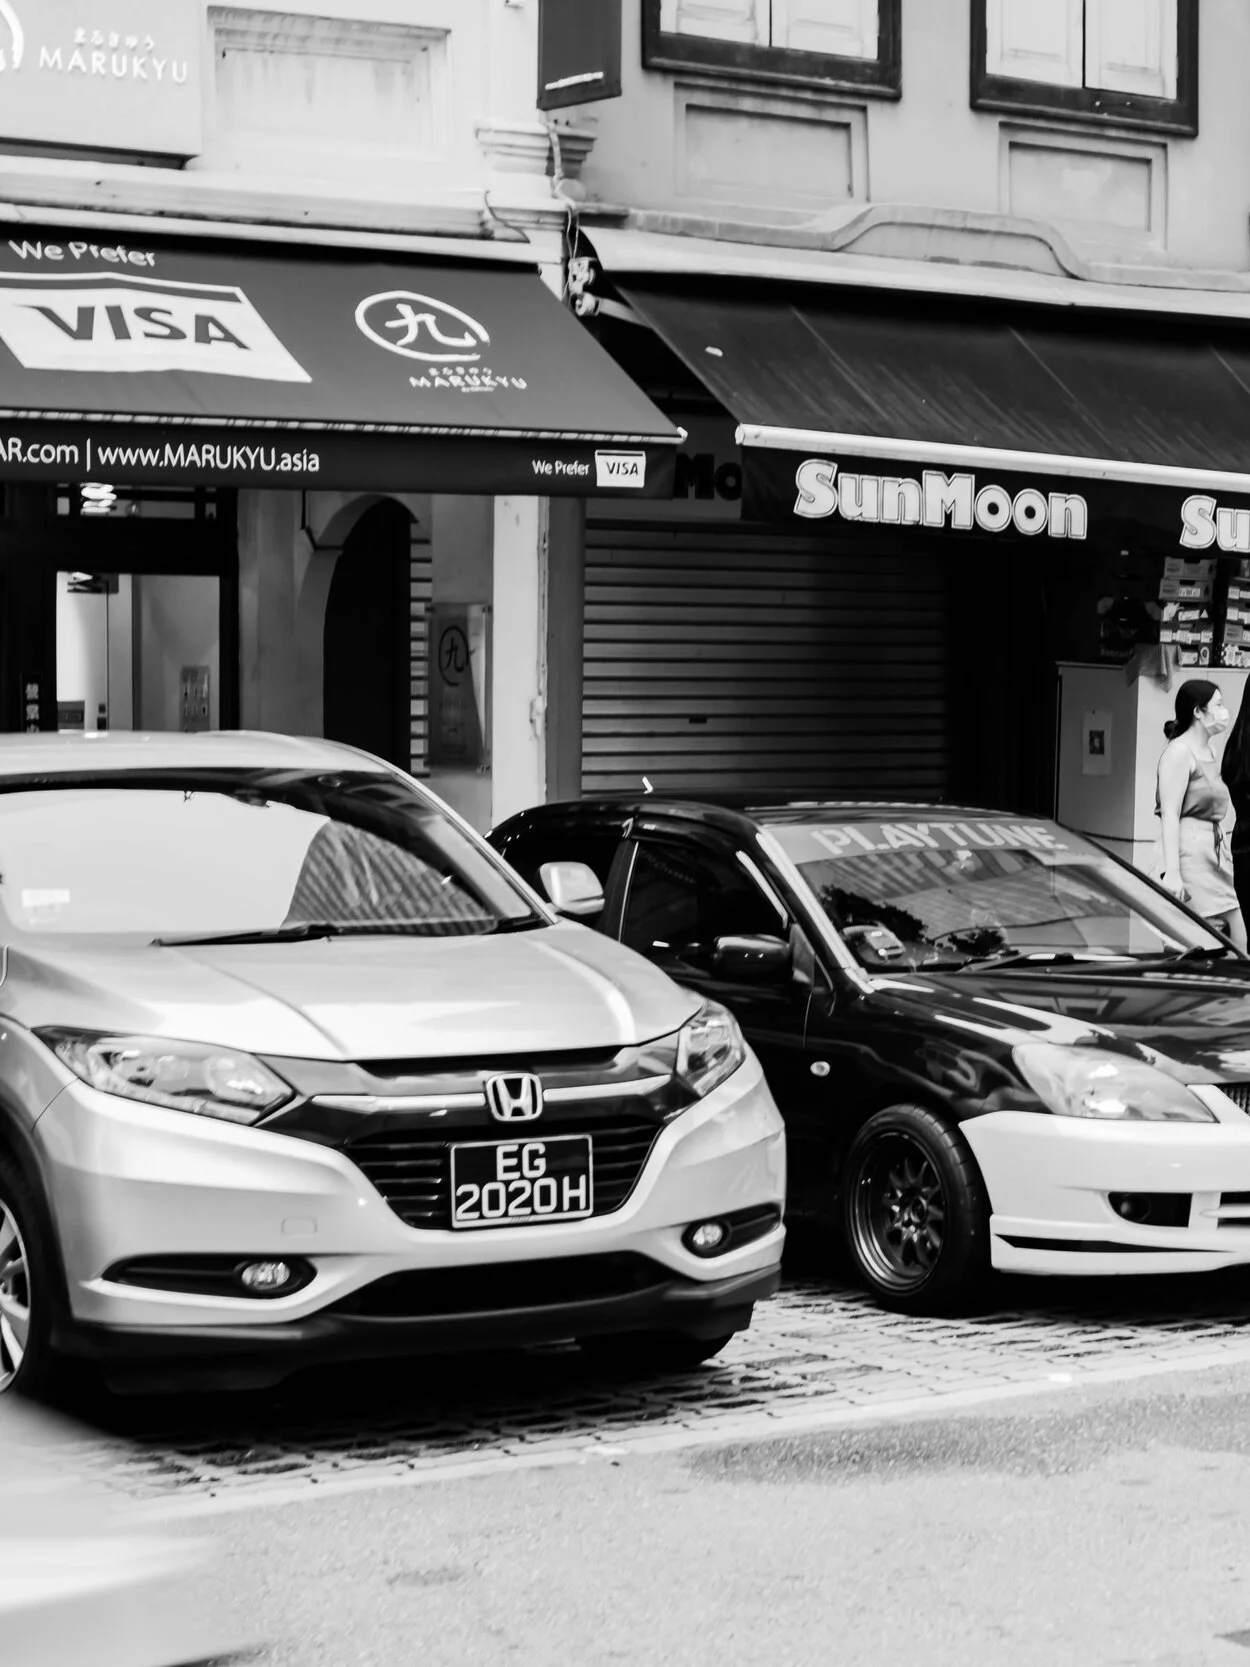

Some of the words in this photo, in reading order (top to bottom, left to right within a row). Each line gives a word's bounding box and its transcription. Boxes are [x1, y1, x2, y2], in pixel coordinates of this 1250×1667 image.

[39, 46, 188, 84] MARUKYU
[8, 240, 64, 260] We
[68, 242, 156, 267] Prefer
[12, 304, 252, 351] VISA
[409, 375, 528, 390] MARUKYU
[98, 443, 320, 473] www.MARUKYU.asia
[531, 459, 553, 475] We
[555, 459, 590, 476] Prefer
[606, 461, 639, 476] VISA
[793, 458, 1087, 540] SunMoon
[810, 823, 1068, 855] PLAYTUNE
[496, 1142, 547, 1181] EG
